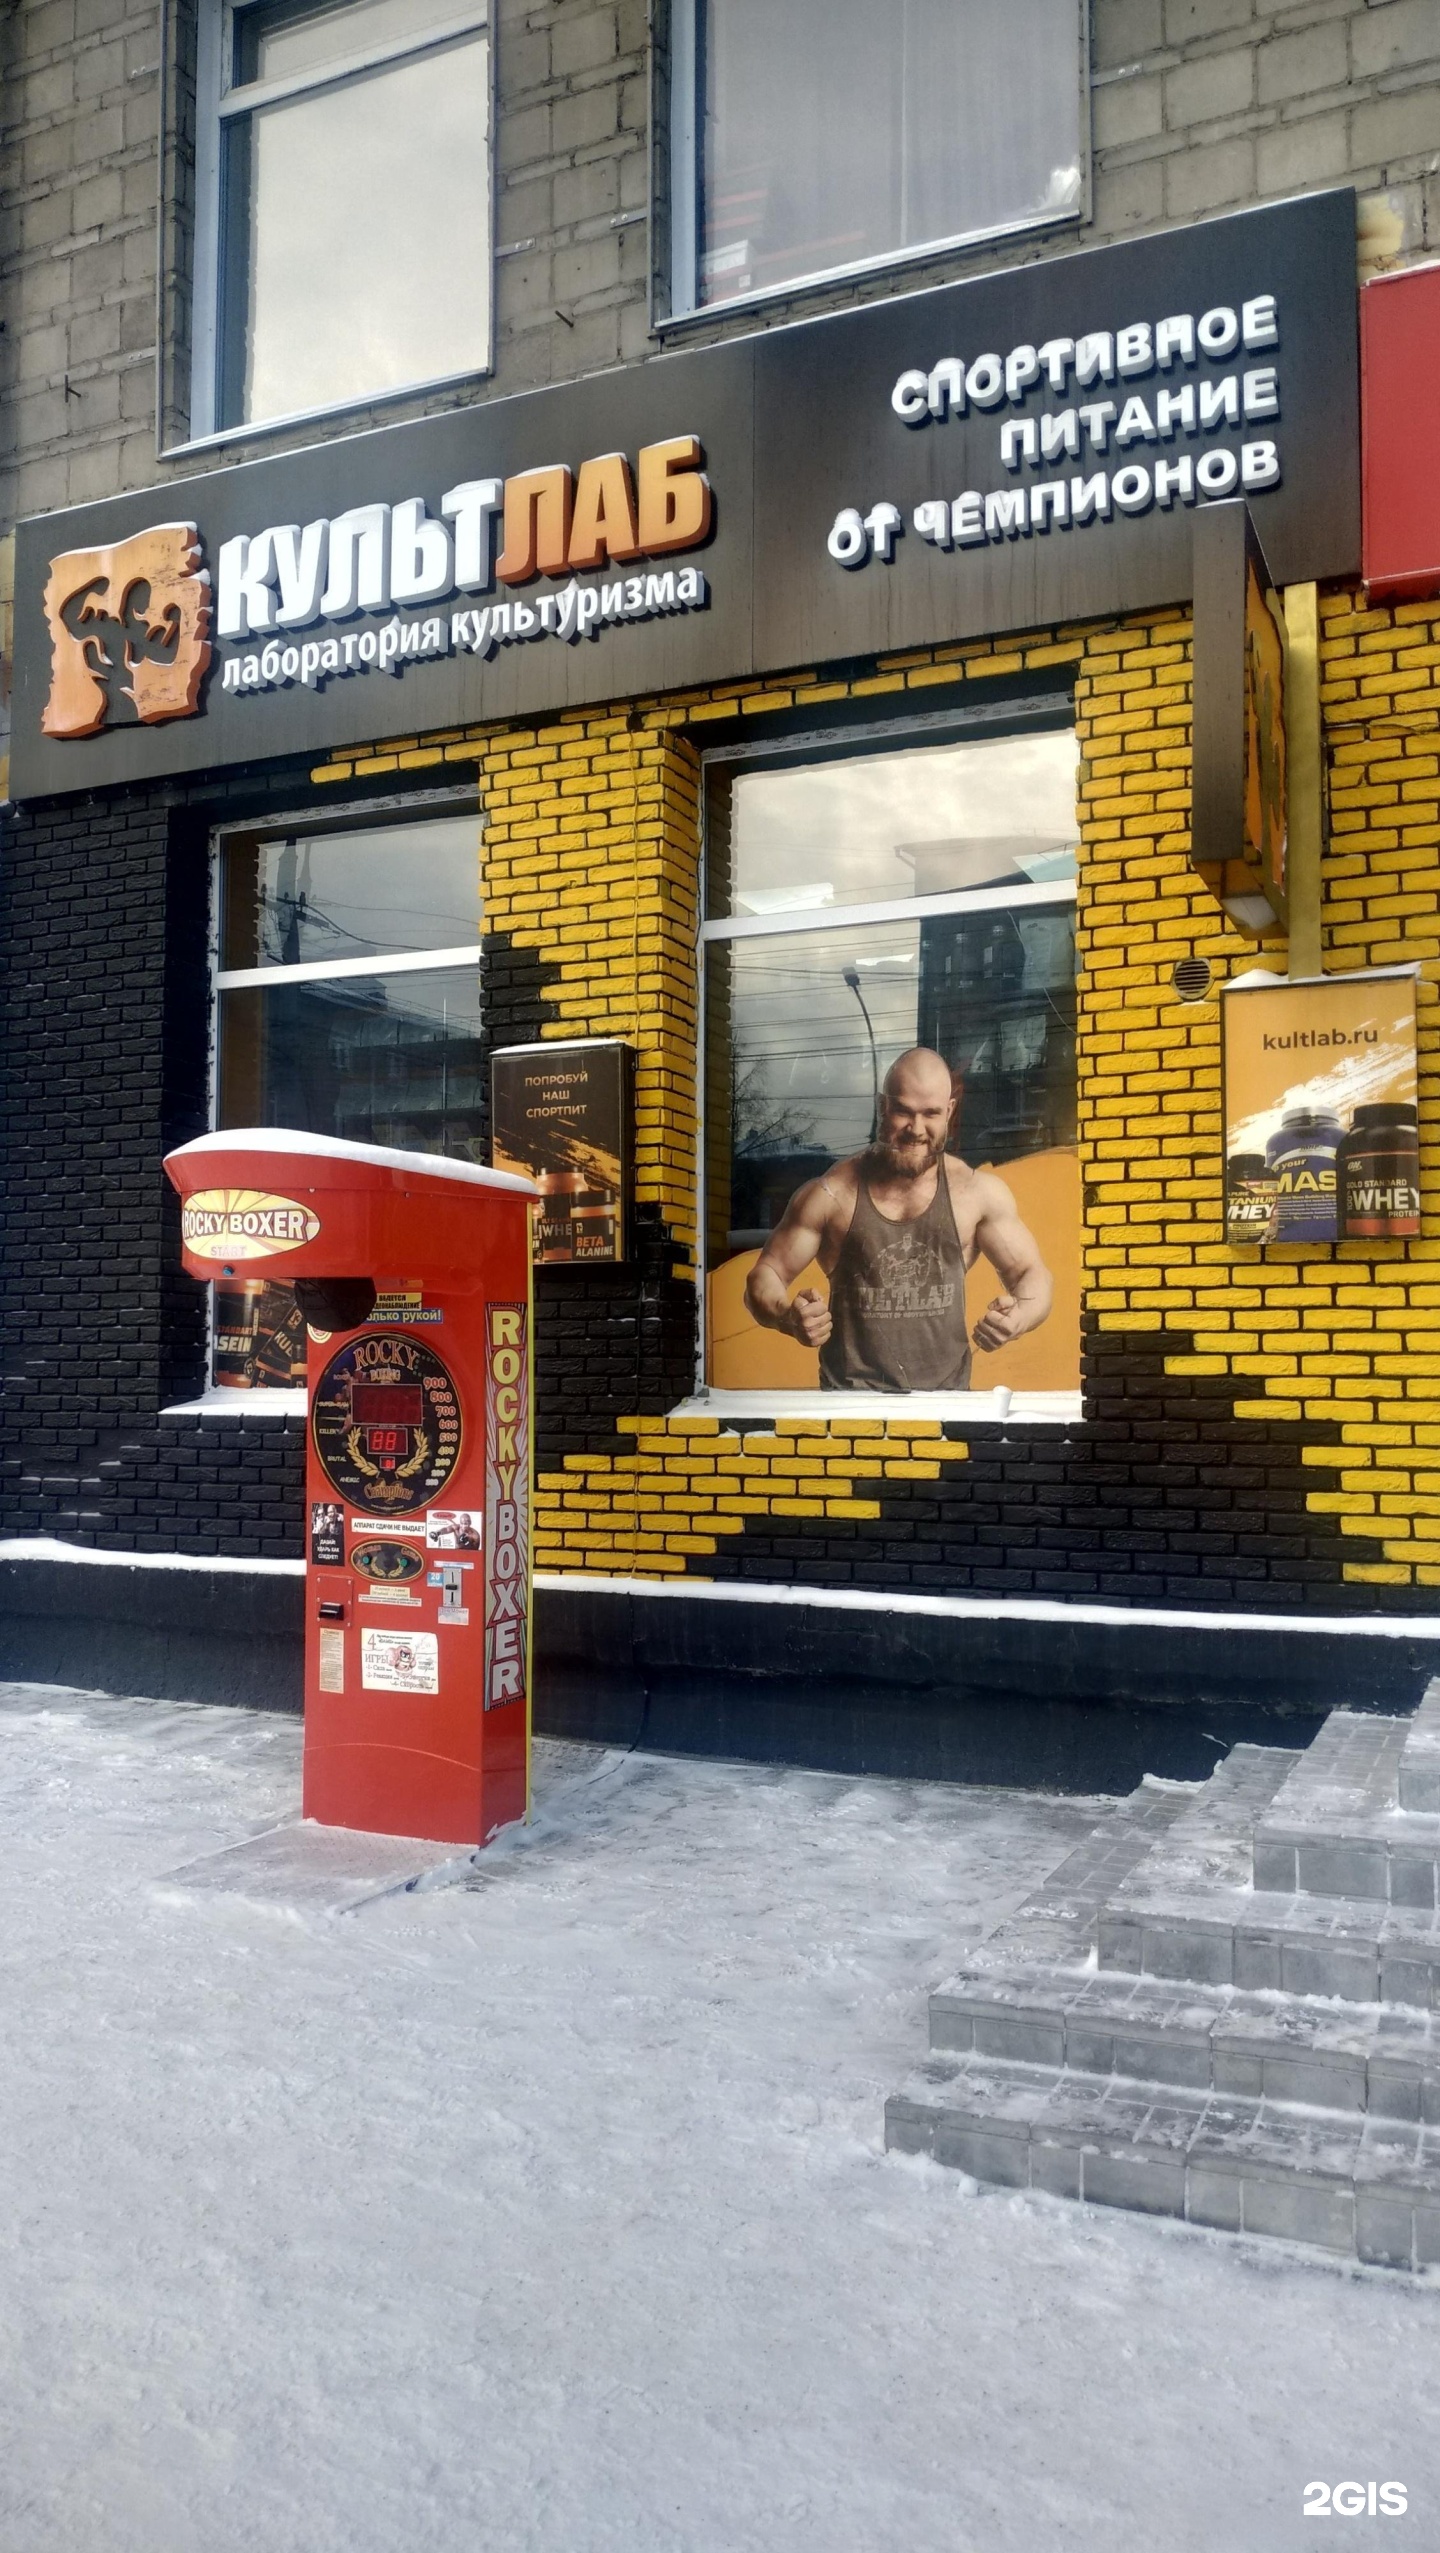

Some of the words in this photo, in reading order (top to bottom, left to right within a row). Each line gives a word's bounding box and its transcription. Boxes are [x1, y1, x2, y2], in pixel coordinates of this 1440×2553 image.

[891, 295, 1278, 423] СПОРТИВНОЕ
[1001, 367, 1279, 468] ПИТАНИЕ
[827, 502, 901, 566] ОТ
[914, 440, 1280, 548] ЧЕМПИОНОВ
[222, 615, 448, 693] лаборатория
[451, 567, 704, 657] культуризма
[1263, 1028, 1378, 1050] kultlab.ru
[525, 1071, 588, 1087] ПОПРОБУЙ
[542, 1090, 570, 1101] НАШ
[526, 1105, 587, 1118] СПОРТПИТ
[1281, 1159, 1306, 1170] your
[1346, 1181, 1362, 1189] GOLD
[184, 1209, 226, 1238] ROCKY
[229, 1210, 305, 1240] BOXER
[576, 1236, 604, 1247] BETA
[210, 1246, 247, 1257] START
[576, 1246, 614, 1257] ALANINE
[402, 1309, 441, 1323] рукой!
[353, 1339, 419, 1371] ROCKY
[423, 1377, 447, 1390] 900
[430, 1391, 452, 1402] 800
[435, 1405, 456, 1417] 700
[492, 1309, 521, 1500] ROCKY
[439, 1419, 458, 1430] 600
[439, 1433, 458, 1443] 500
[354, 1521, 375, 1529] АППАРАТ
[493, 1503, 520, 1701] BOXER
[365, 1653, 389, 1664] ИГРЫ
